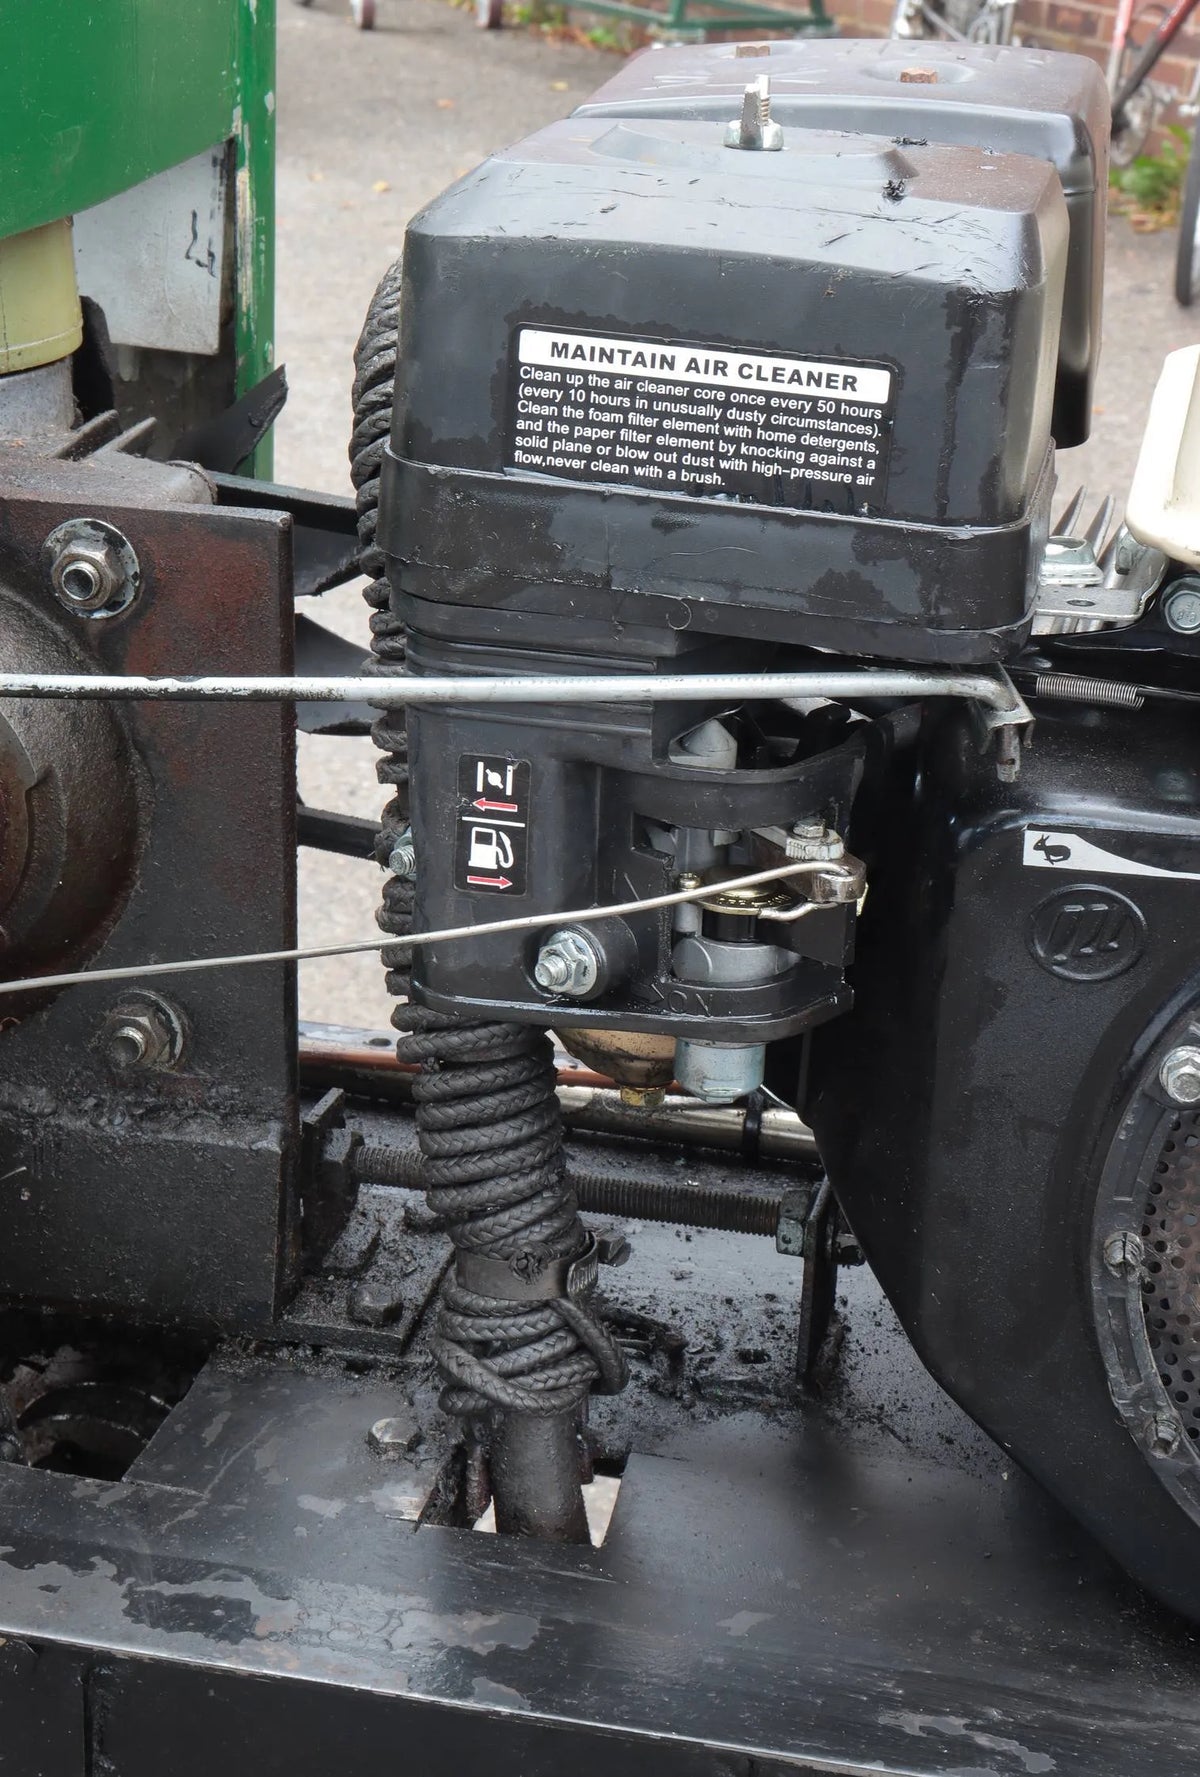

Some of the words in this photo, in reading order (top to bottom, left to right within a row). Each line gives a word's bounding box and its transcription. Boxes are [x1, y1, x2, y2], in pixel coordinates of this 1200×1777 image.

[551, 342, 675, 371] MAINTAIN
[685, 358, 728, 377] AIR
[738, 364, 857, 392] CLEANER
[518, 384, 564, 403] (every
[569, 389, 586, 403] 10
[590, 392, 631, 408] hours
[635, 397, 648, 410] in
[653, 400, 723, 420] unusually
[726, 407, 767, 425] dusty
[770, 412, 882, 438] circumstances).
[520, 367, 562, 383] Clean
[566, 374, 584, 388] up
[588, 374, 611, 388] the
[614, 378, 634, 391] air
[636, 380, 690, 397] cleaner
[693, 388, 726, 402] core
[730, 392, 766, 406] once
[770, 397, 813, 413] every
[817, 399, 836, 414] 50
[840, 402, 882, 419] hours
[516, 419, 543, 432] and
[547, 421, 570, 435] the
[574, 426, 616, 441] paper
[619, 429, 653, 444] filter
[656, 434, 715, 452] element
[718, 440, 737, 456] by
[740, 442, 806, 464] knocking
[809, 452, 864, 468] against
[866, 459, 876, 470] a
[517, 400, 558, 417] Clean
[562, 405, 585, 420] the
[588, 408, 624, 424] foam
[627, 412, 660, 428] filter
[662, 417, 720, 435] element
[723, 424, 752, 439] with
[756, 427, 797, 444] home
[800, 432, 880, 454] detergents,
[514, 451, 587, 470] flow,never
[590, 460, 630, 475] clean
[633, 465, 663, 479] with
[667, 470, 677, 480] a
[681, 469, 726, 486] brush.
[515, 435, 548, 449] solid
[552, 439, 592, 454] plane
[596, 445, 612, 456] or
[615, 445, 650, 460] blow
[653, 451, 678, 464] out
[682, 453, 715, 468] dust
[719, 458, 748, 472] with
[752, 460, 853, 484] high-pressure
[856, 473, 876, 486] air
